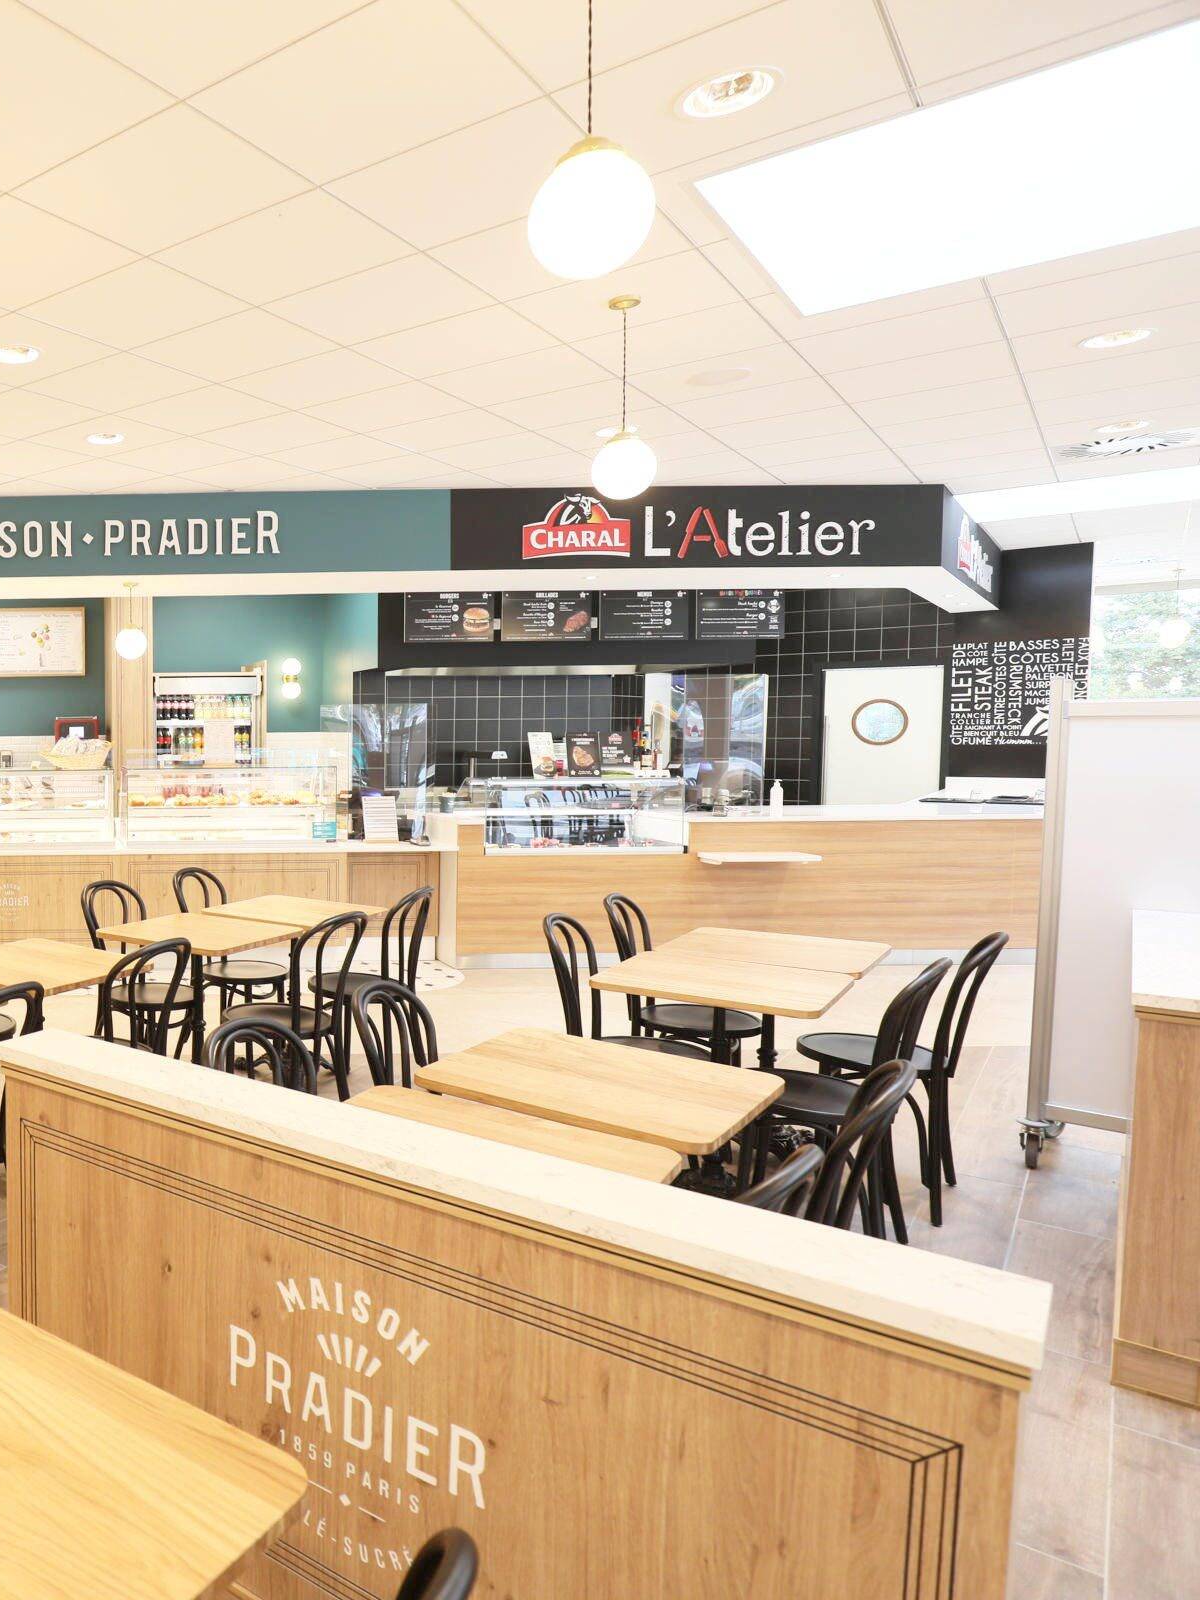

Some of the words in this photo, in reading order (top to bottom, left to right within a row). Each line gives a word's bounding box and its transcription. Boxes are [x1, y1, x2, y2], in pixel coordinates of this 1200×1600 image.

[102, 510, 281, 557] PRADIER
[529, 528, 626, 550] CHARAL
[644, 505, 876, 559] L'Atelier
[966, 642, 988, 650] PLAT
[992, 641, 1007, 666] GÎTE
[1009, 639, 1060, 652] BASSES
[1062, 637, 1075, 663] FILET
[1077, 637, 1090, 662] FAUX
[952, 657, 989, 667] HAMPE
[1008, 652, 1060, 665] CÔTES
[1025, 663, 1074, 674] BAVETTE
[973, 665, 993, 712] STEAK
[1025, 681, 1051, 689] SURP
[1074, 662, 1089, 700] NGLET
[993, 666, 1008, 725] ENTRECÔTES
[1007, 665, 1024, 725] RUMSTECK
[1024, 698, 1051, 706] JUME
[962, 735, 992, 746] FUMÉ
[276, 1277, 431, 1366] MAISON
[229, 1324, 487, 1510] PRADIER
[279, 1428, 333, 1469] 1859
[346, 1462, 421, 1514] PARIS
[303, 1509, 414, 1572] LÉ-SUCRÉ
